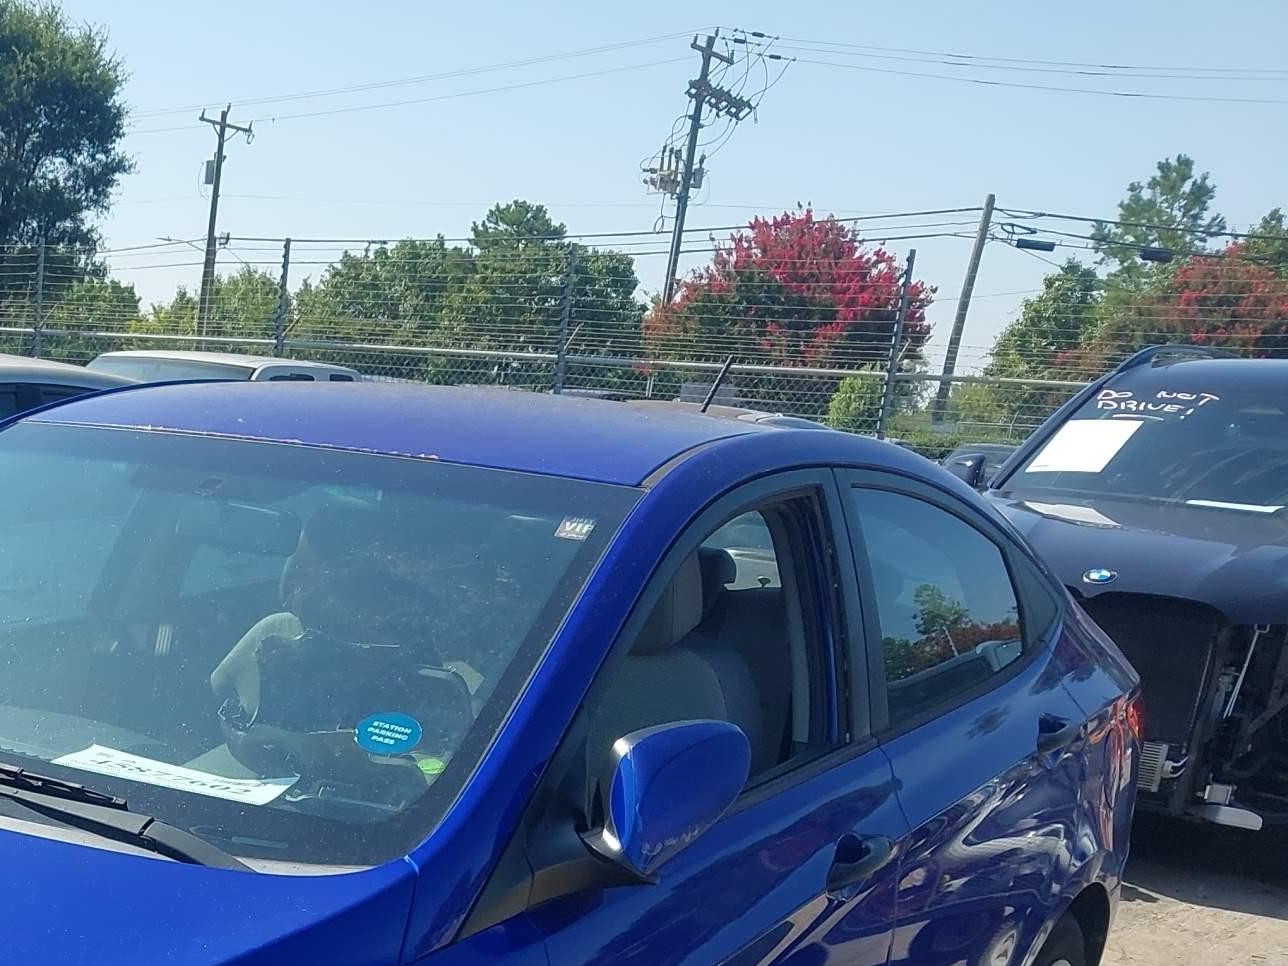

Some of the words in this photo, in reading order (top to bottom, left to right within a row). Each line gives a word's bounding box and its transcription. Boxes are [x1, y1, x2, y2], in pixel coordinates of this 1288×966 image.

[1096, 389, 1134, 400] DO
[1156, 390, 1220, 406] NOT
[1096, 400, 1194, 420] DRIVE!
[367, 726, 409, 741] PARKING
[372, 720, 412, 734] STATION
[370, 735, 395, 745] PASS
